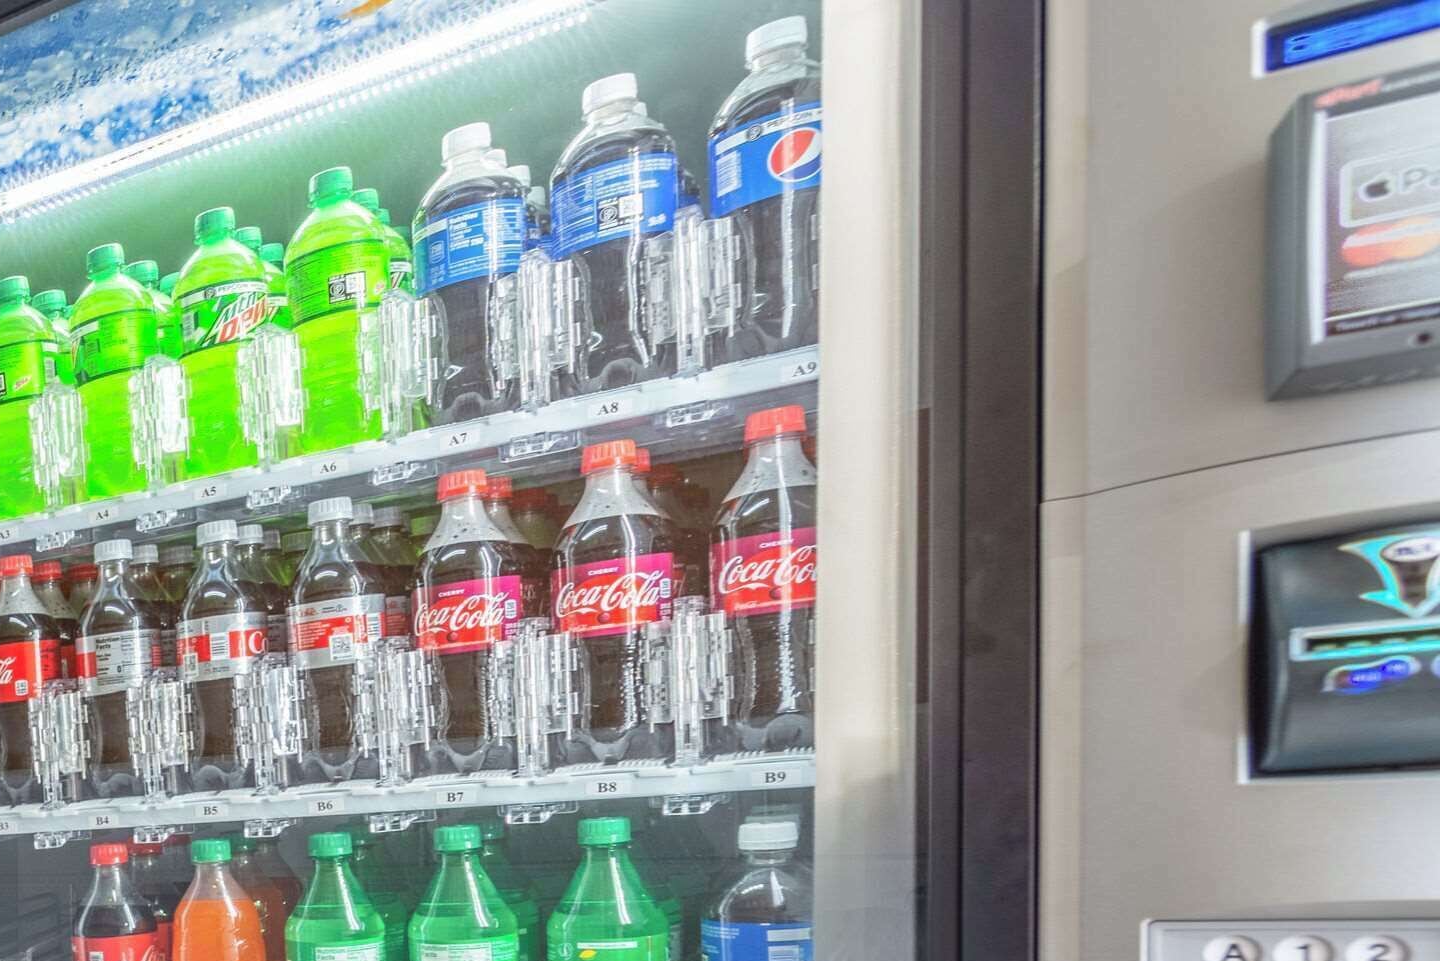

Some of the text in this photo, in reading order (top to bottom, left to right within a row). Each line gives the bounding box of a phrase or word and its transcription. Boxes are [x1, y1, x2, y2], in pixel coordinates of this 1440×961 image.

[792, 360, 817, 377] A9
[597, 401, 619, 416] A8
[448, 432, 467, 447] A7
[320, 462, 337, 473] A6
[202, 486, 217, 498] A5
[96, 510, 109, 520] A4
[718, 545, 816, 594] Coca-Co
[555, 570, 664, 618] Coca-Cola
[414, 592, 509, 636] Coca-Cola
[764, 771, 786, 784] B9
[597, 781, 617, 793] B8
[446, 791, 464, 803] B7
[203, 805, 218, 816] B5
[317, 800, 334, 811] B6
[96, 816, 109, 826] B4
